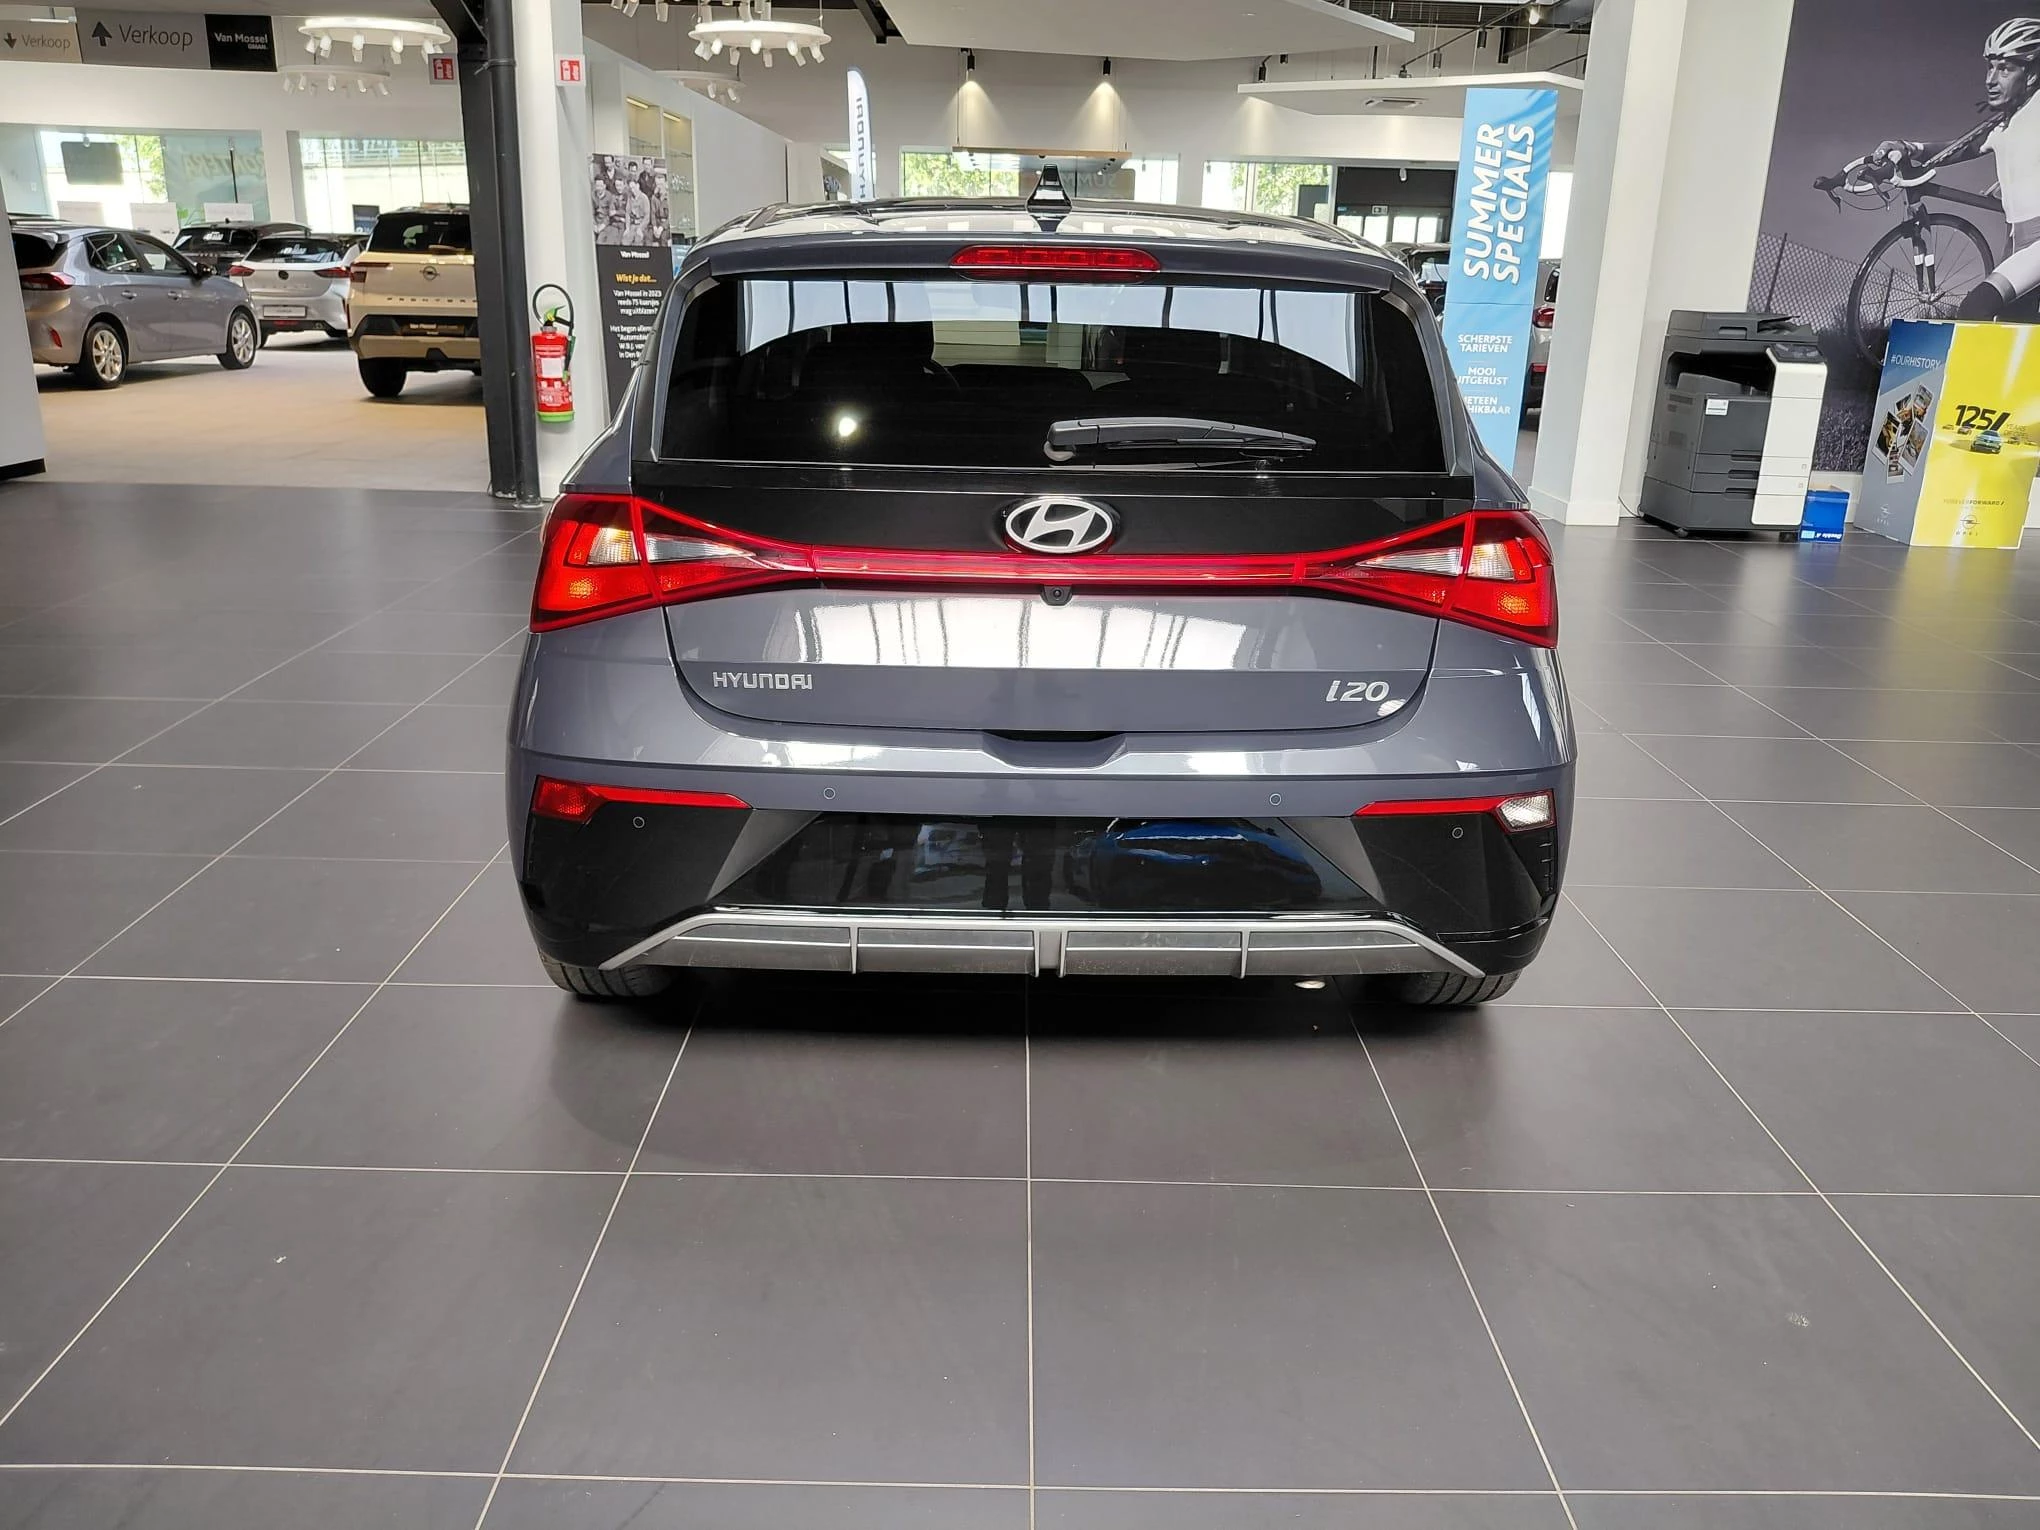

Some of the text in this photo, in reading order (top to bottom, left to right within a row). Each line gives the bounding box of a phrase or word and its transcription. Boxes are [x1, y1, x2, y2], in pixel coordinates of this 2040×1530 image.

[21, 33, 71, 52] Verkoop
[118, 23, 193, 51] Verkoop
[214, 32, 268, 44] Van Mossel
[856, 97, 866, 199] HYUNDAI
[1463, 123, 1505, 280] SUMMER
[1492, 123, 1535, 285] SPECIALS
[615, 273, 632, 283] Wist
[613, 289, 624, 297] Van
[1458, 334, 1512, 344] SCHERPSTE
[1460, 343, 1509, 353] TARIEVEN
[1891, 354, 1941, 370] #OURHISTORY
[1467, 367, 1496, 376] MOOI
[712, 671, 813, 690] HYUNDAI
[1325, 680, 1390, 702] i20
